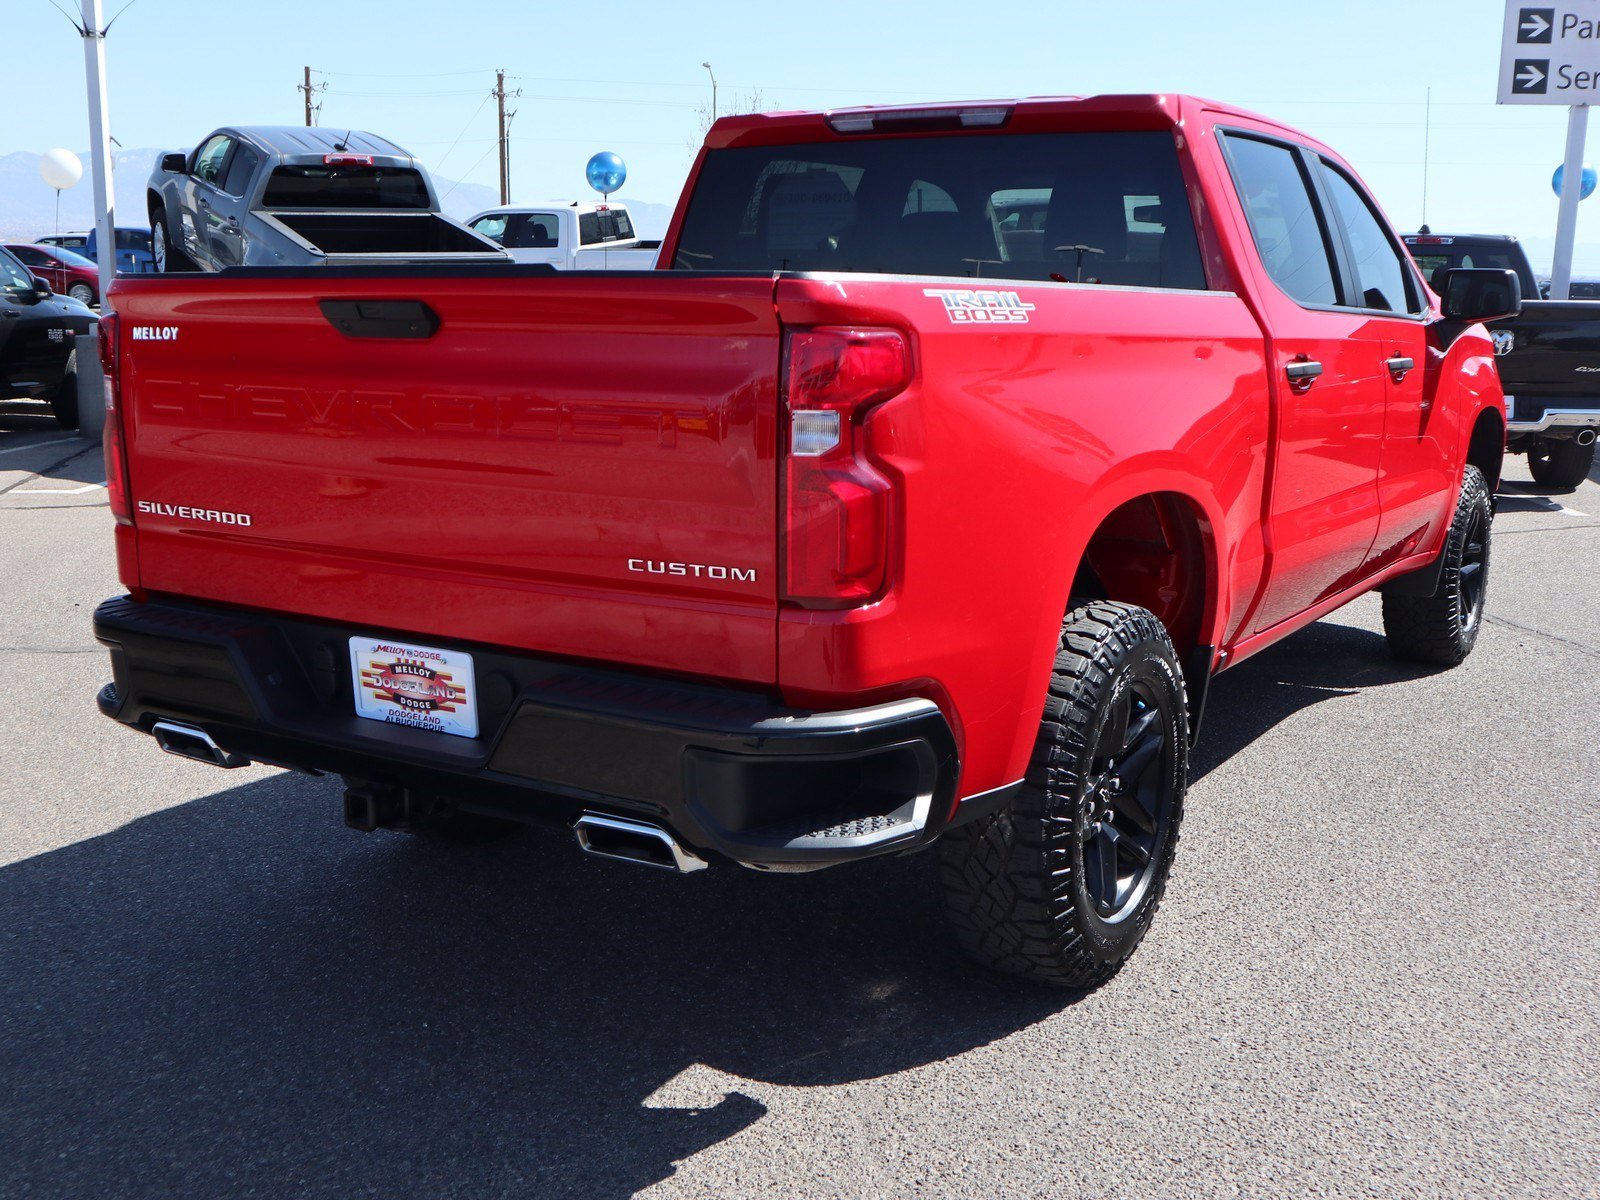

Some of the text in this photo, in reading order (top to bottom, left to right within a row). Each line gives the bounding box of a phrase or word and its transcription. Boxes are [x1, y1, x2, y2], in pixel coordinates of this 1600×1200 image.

[923, 289, 1036, 310] TRAIL
[948, 308, 1029, 323] BOSS
[133, 326, 179, 340] MELLOY
[144, 377, 709, 450] CHEVROLET
[138, 500, 251, 527] SILVERADO
[628, 558, 756, 582] CUSTOM
[375, 644, 441, 661] MELLOY DODGE
[395, 666, 431, 678] MELLOY
[371, 675, 457, 699] DODGELAND
[400, 697, 431, 709] DODGE
[385, 716, 446, 732] ALBUQUERQUE
[389, 709, 441, 725] DODGELAND
